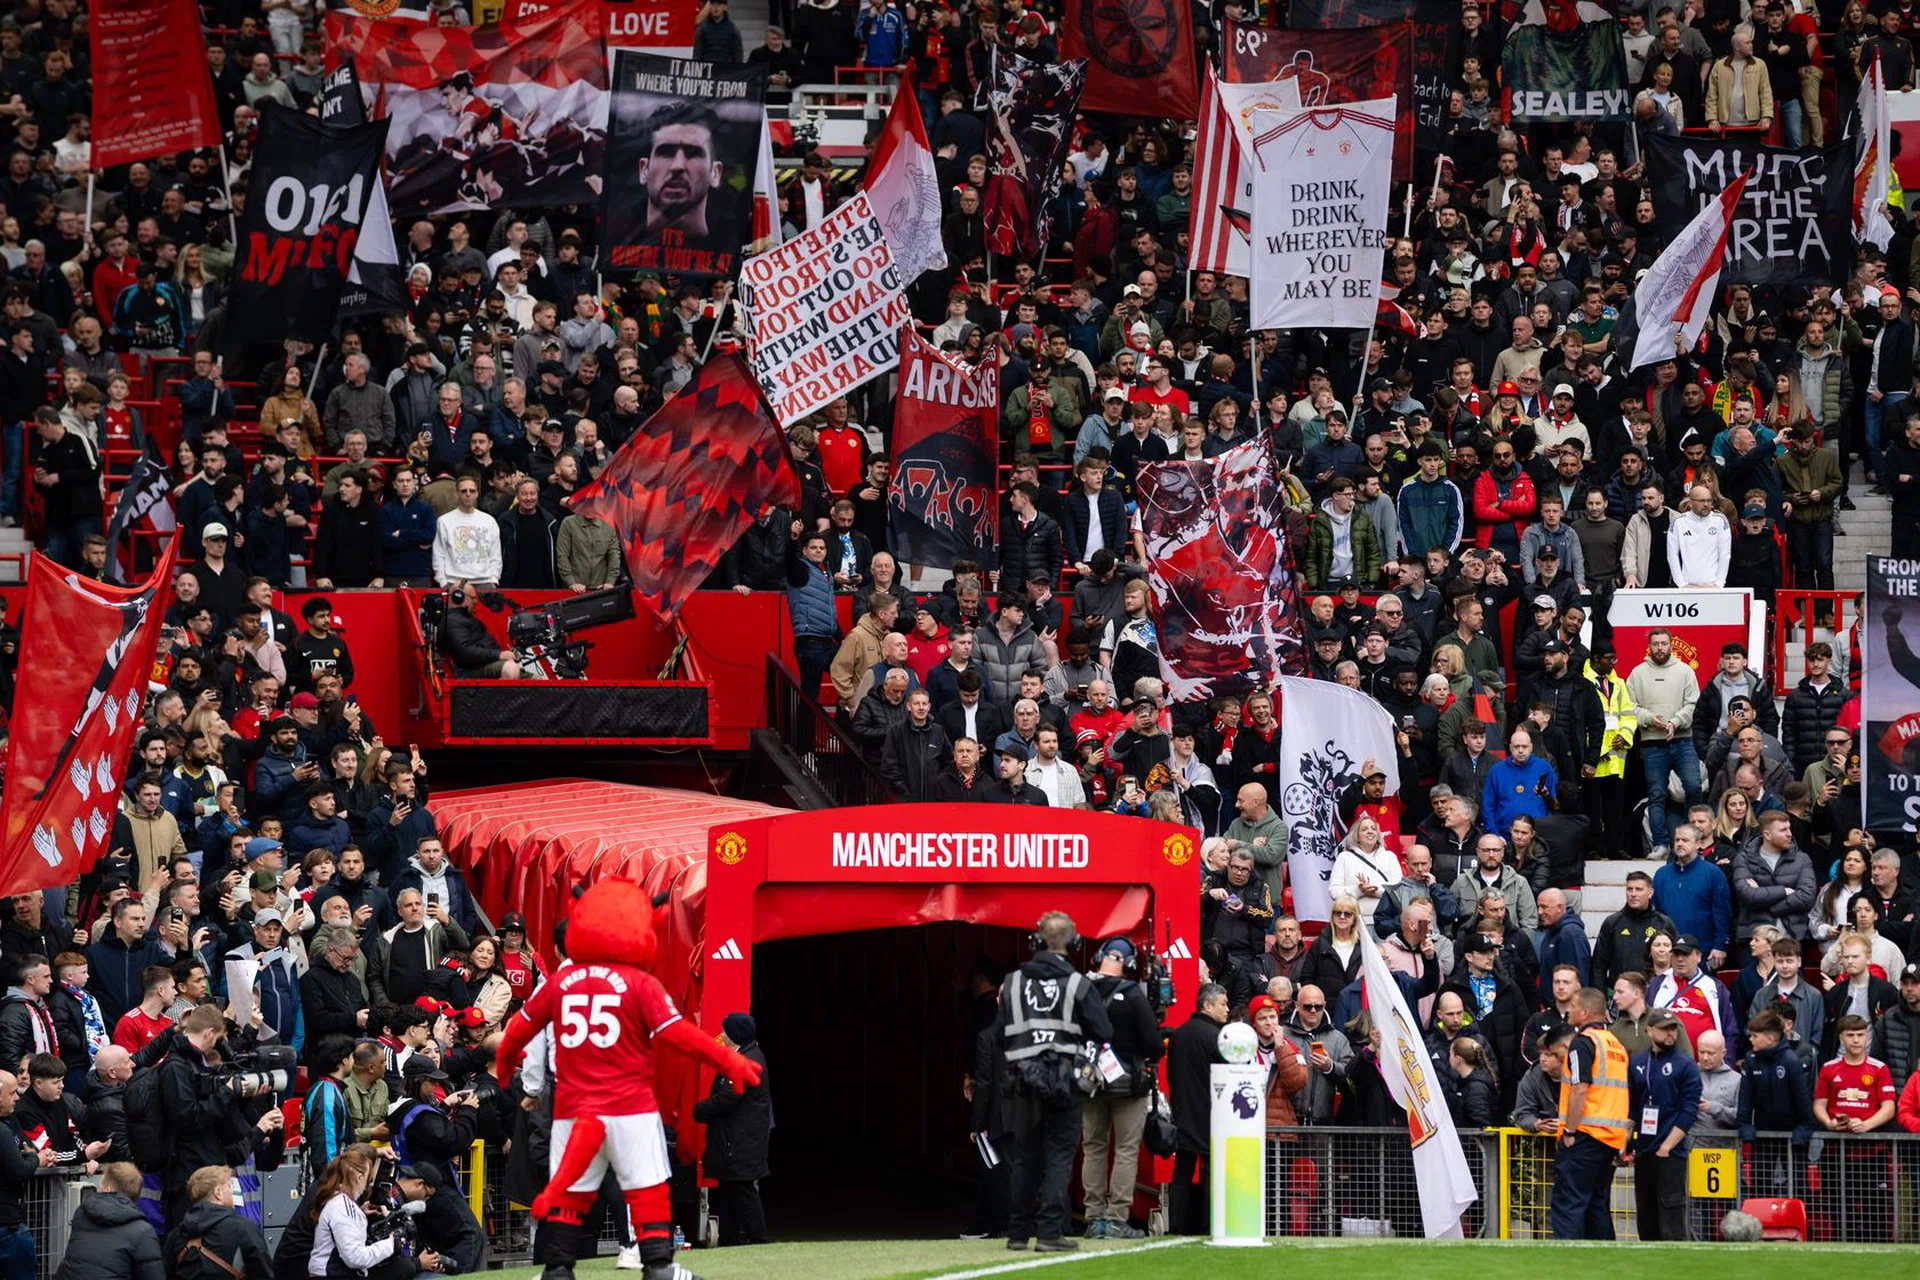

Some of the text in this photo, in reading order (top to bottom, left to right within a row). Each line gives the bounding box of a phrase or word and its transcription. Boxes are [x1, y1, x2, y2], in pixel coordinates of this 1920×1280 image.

[610, 12, 670, 35] LOVE
[335, 67, 352, 87] ME
[670, 59, 714, 79] IT AIN'T
[635, 72, 748, 98] WHERE YOU'RE FROM
[1511, 89, 1631, 116] SEALEY!
[1419, 104, 1441, 128] End
[1291, 179, 1365, 202] DRINK,
[1744, 187, 1818, 218] THE
[1292, 204, 1365, 227] DRINK,
[662, 228, 684, 246] IT'S
[1266, 227, 1386, 254] WHEREVER
[1724, 218, 1831, 262] REA
[611, 245, 732, 274] WHERE YOU'RE AT
[1306, 251, 1352, 274] YOU
[1284, 276, 1372, 300] MAY BE
[1887, 578, 1918, 596] THE
[1644, 603, 1699, 618] W106
[1888, 774, 1910, 791] TO
[832, 832, 1089, 868] MANCHESTER UNITED
[560, 994, 622, 1049] 55
[1032, 1030, 1055, 1043] 177
[1703, 1153, 1722, 1164] WSP
[1707, 1167, 1719, 1193] 6
